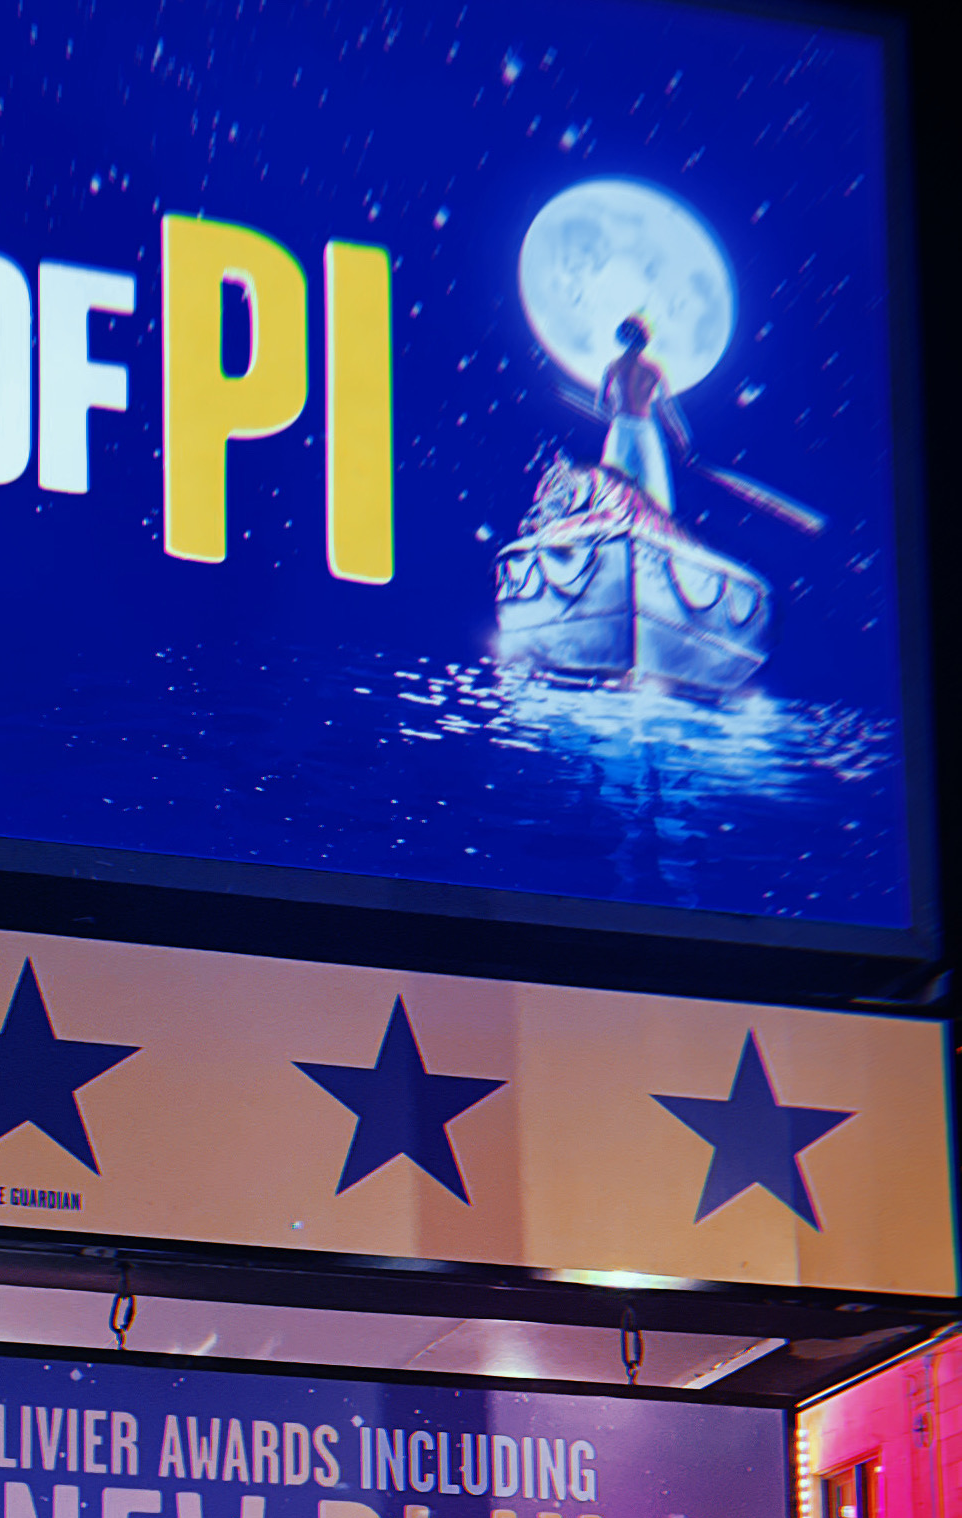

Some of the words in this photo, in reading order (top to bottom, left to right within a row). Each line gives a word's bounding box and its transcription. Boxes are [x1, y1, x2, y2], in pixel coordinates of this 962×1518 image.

[162, 213, 393, 585] PI
[10, 1188, 83, 1211] GUARDIAN
[158, 1415, 339, 1487] AWARDS
[360, 1426, 597, 1501] INCLUDING
